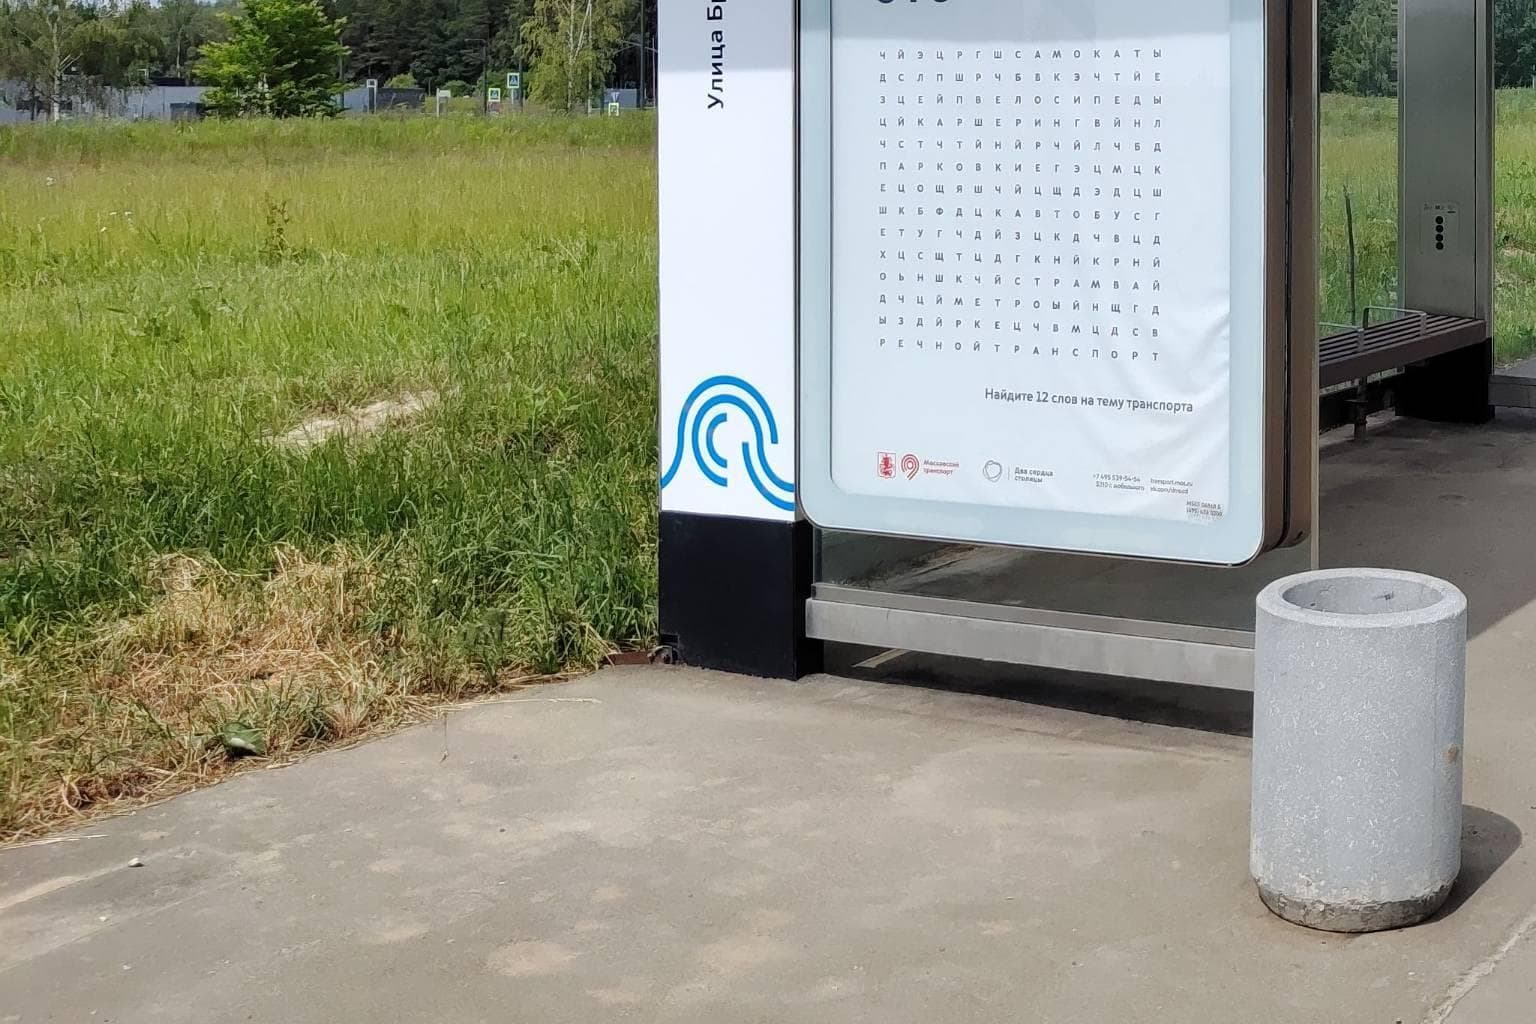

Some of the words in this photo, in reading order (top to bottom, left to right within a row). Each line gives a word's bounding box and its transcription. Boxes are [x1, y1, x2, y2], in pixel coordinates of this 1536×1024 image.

[707, 30, 725, 109] Улица
[984, 388, 1034, 403] Найдите
[1036, 391, 1049, 403] 12
[1051, 394, 1078, 405] слов
[1080, 396, 1094, 406] на
[1097, 397, 1125, 409] тему
[1126, 398, 1193, 414] транспорта
